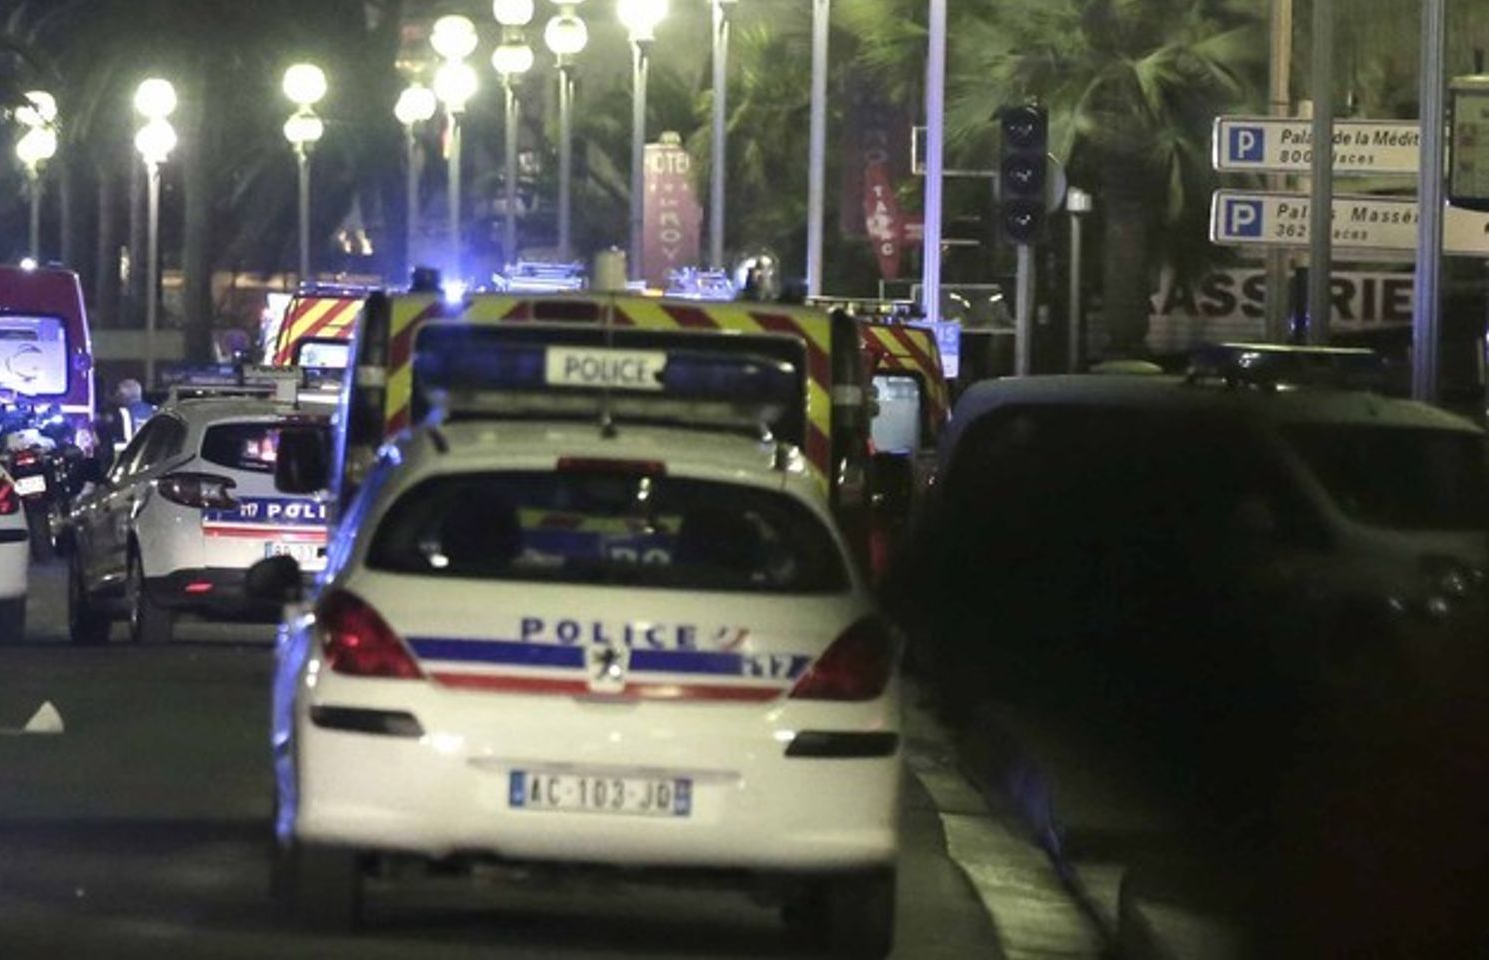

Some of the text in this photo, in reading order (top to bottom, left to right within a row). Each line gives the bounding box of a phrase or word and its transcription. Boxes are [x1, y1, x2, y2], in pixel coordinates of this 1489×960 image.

[1355, 131, 1370, 146] la
[1372, 130, 1420, 147] Médit
[1351, 206, 1419, 224] Massé
[565, 354, 650, 383] POLICE
[267, 503, 326, 519] POLI
[520, 617, 697, 650] POLICE
